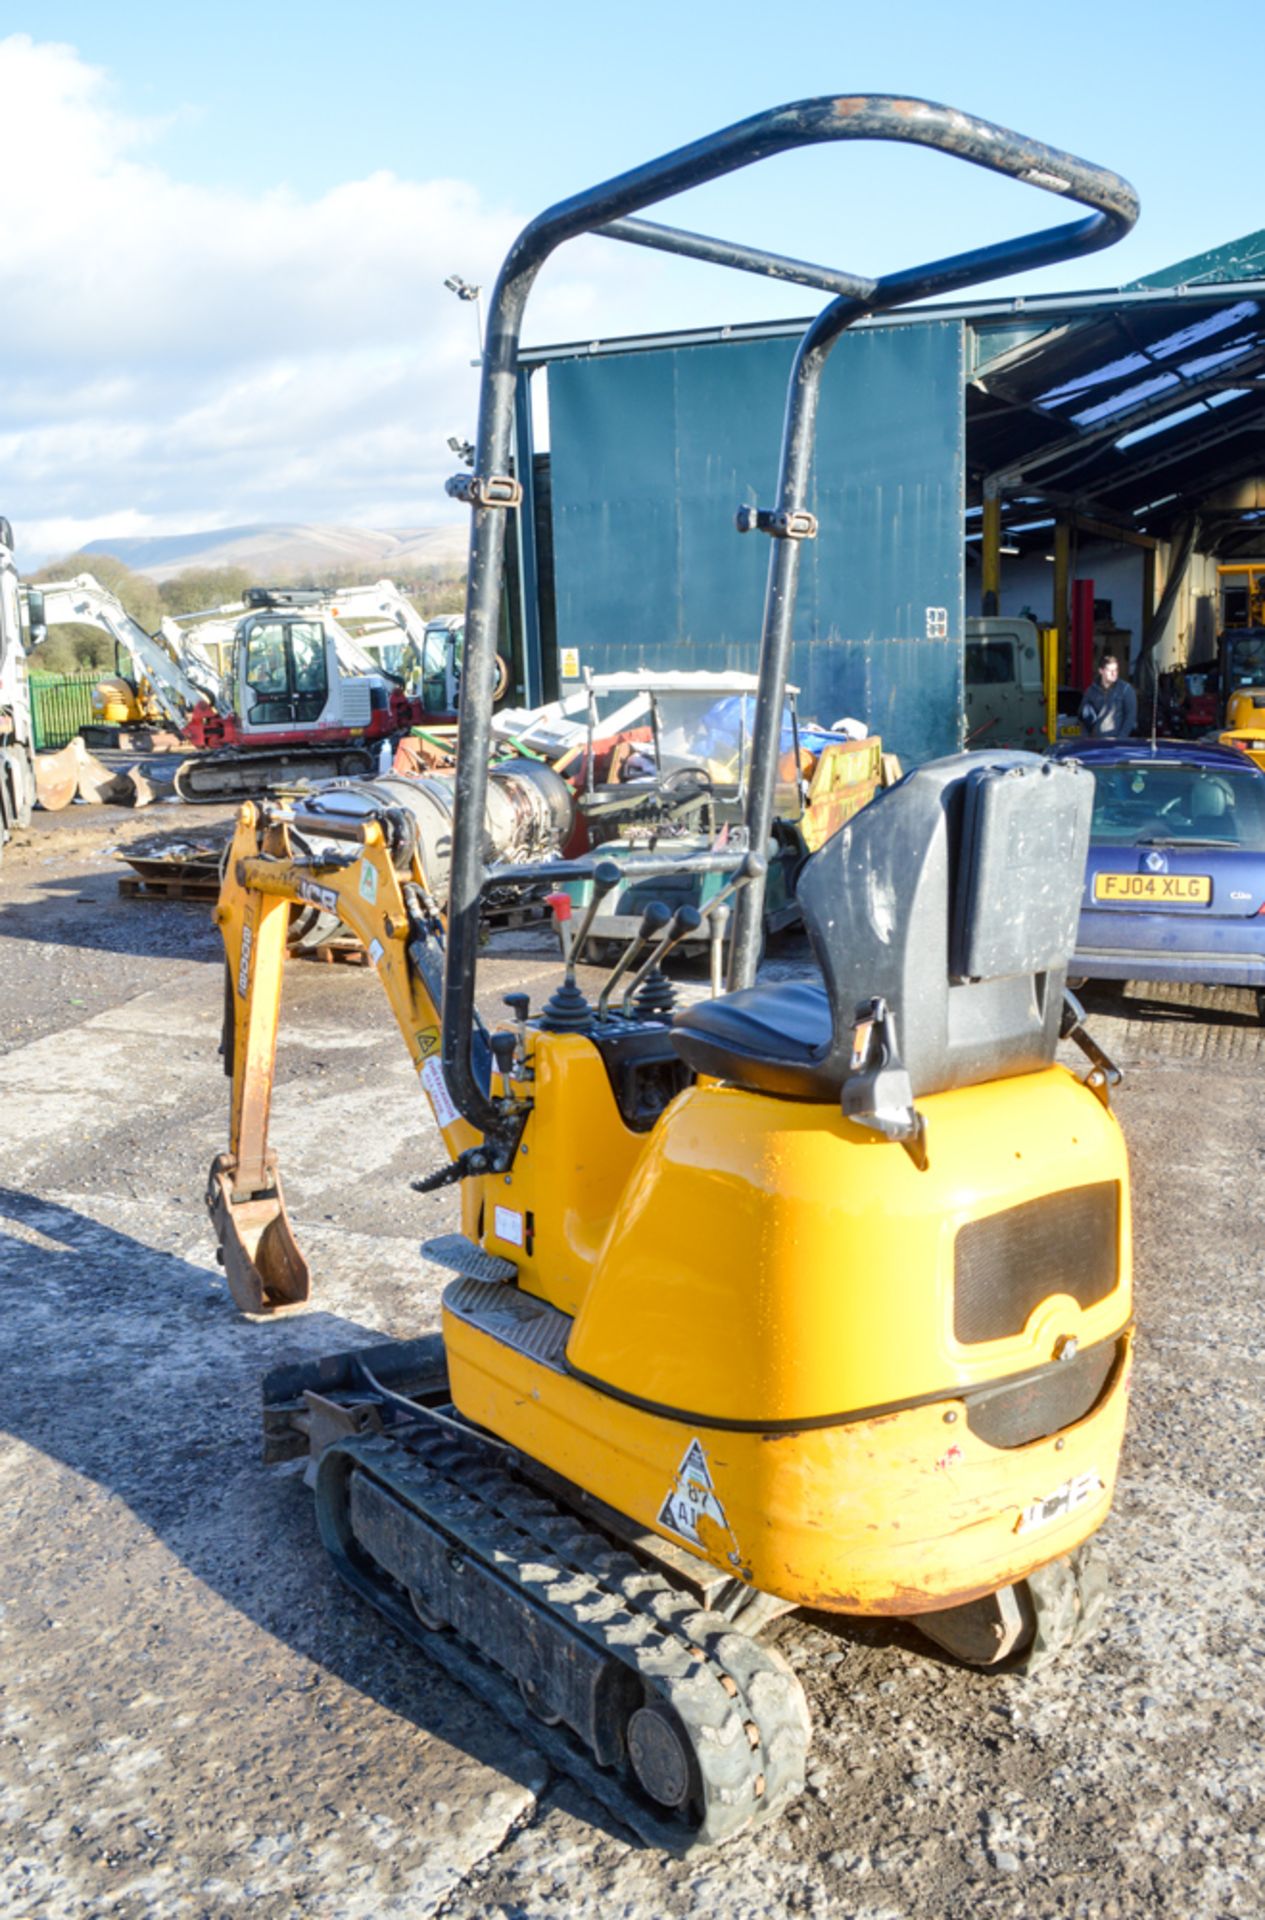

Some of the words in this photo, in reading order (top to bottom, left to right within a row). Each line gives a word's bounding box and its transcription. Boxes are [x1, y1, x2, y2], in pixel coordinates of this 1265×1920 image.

[297, 878, 339, 914] JCB
[1105, 876, 1157, 894] FJ04
[1162, 878, 1201, 898] XLG
